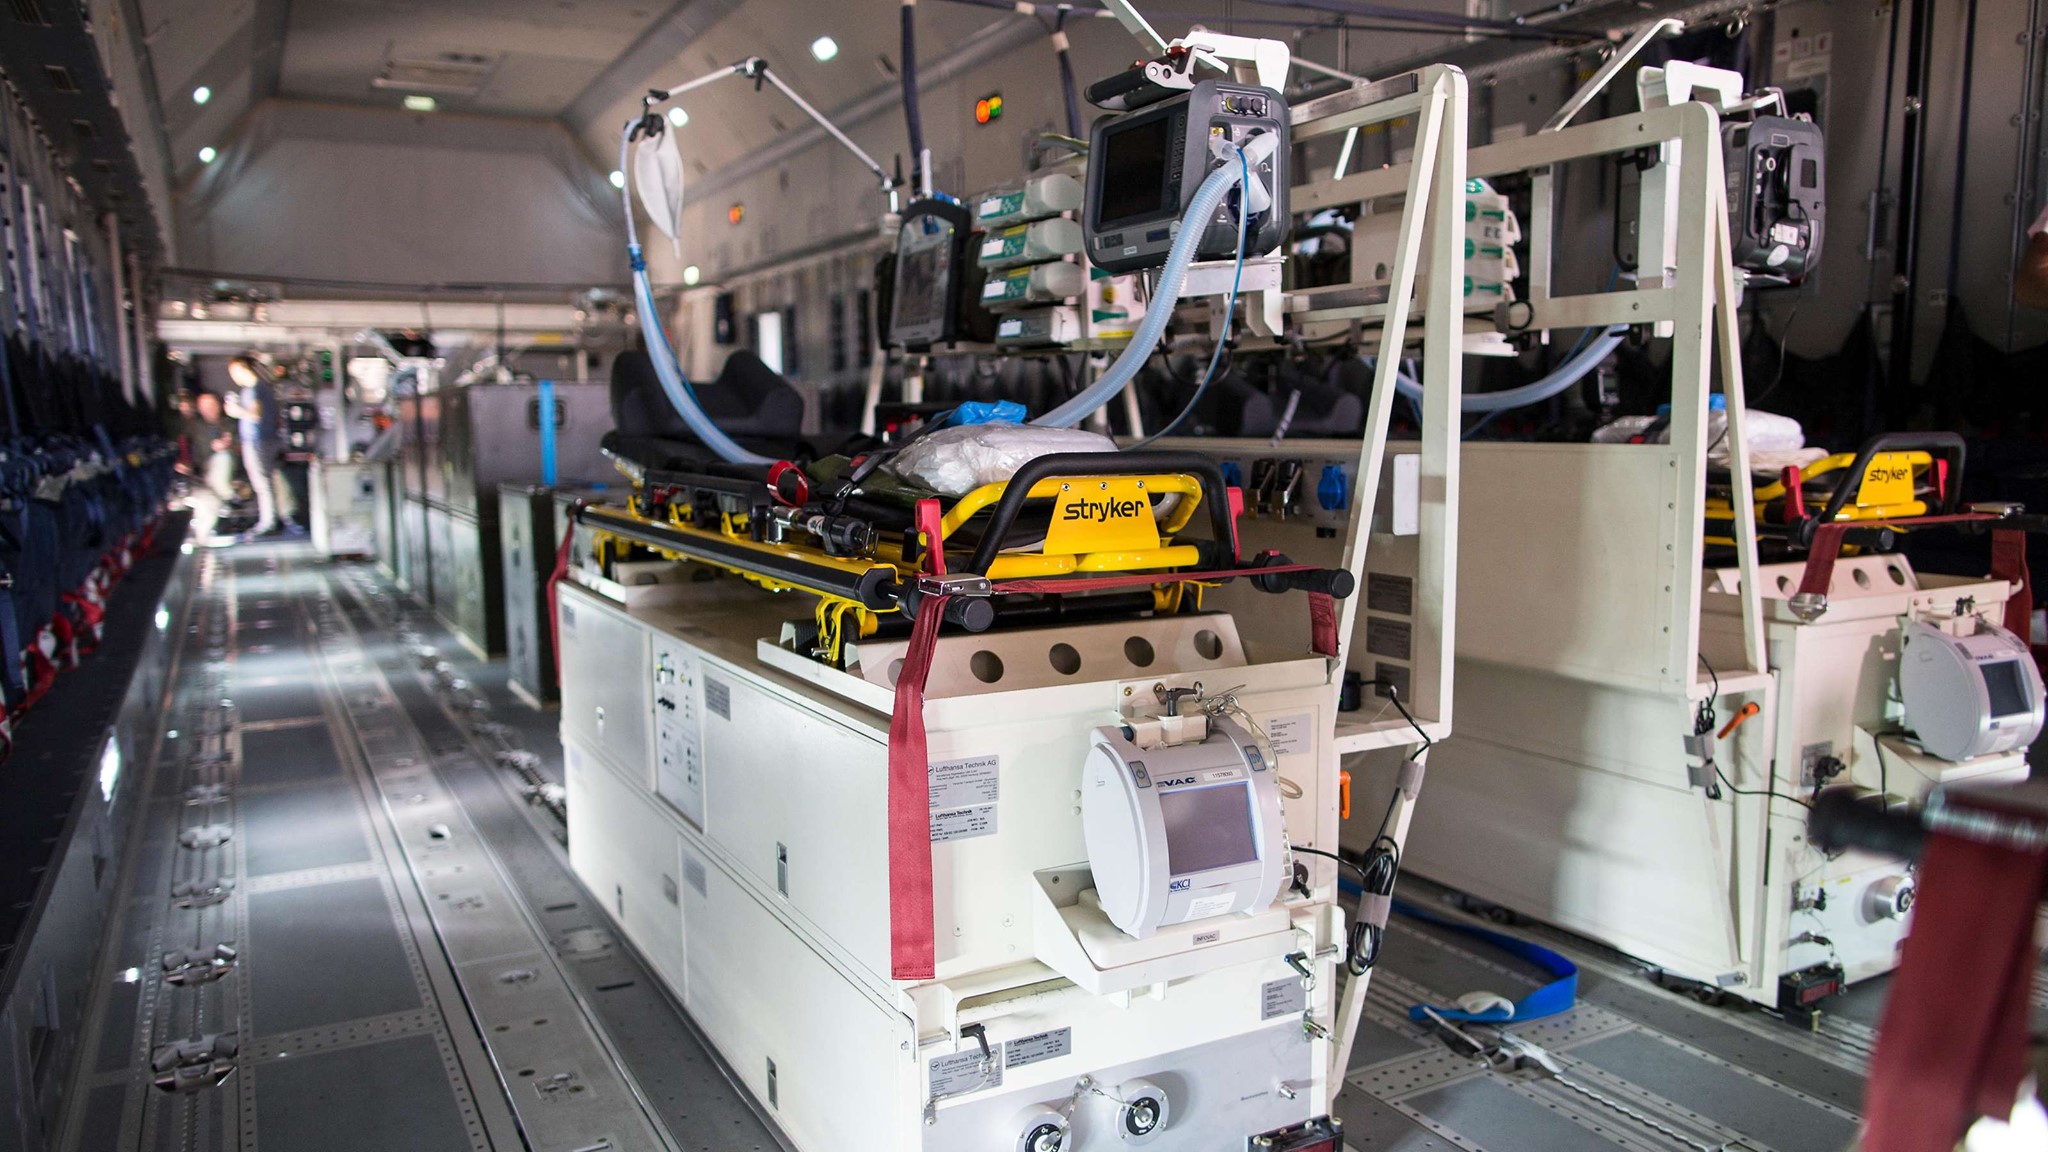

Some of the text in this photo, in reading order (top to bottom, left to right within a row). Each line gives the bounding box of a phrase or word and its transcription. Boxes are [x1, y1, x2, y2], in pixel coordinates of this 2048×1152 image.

[1868, 466, 1908, 483] stryker
[1063, 497, 1144, 522] stryker
[936, 763, 964, 773] Lufthansa
[965, 761, 986, 770] Technik
[941, 1057, 968, 1067] Lufthansa
